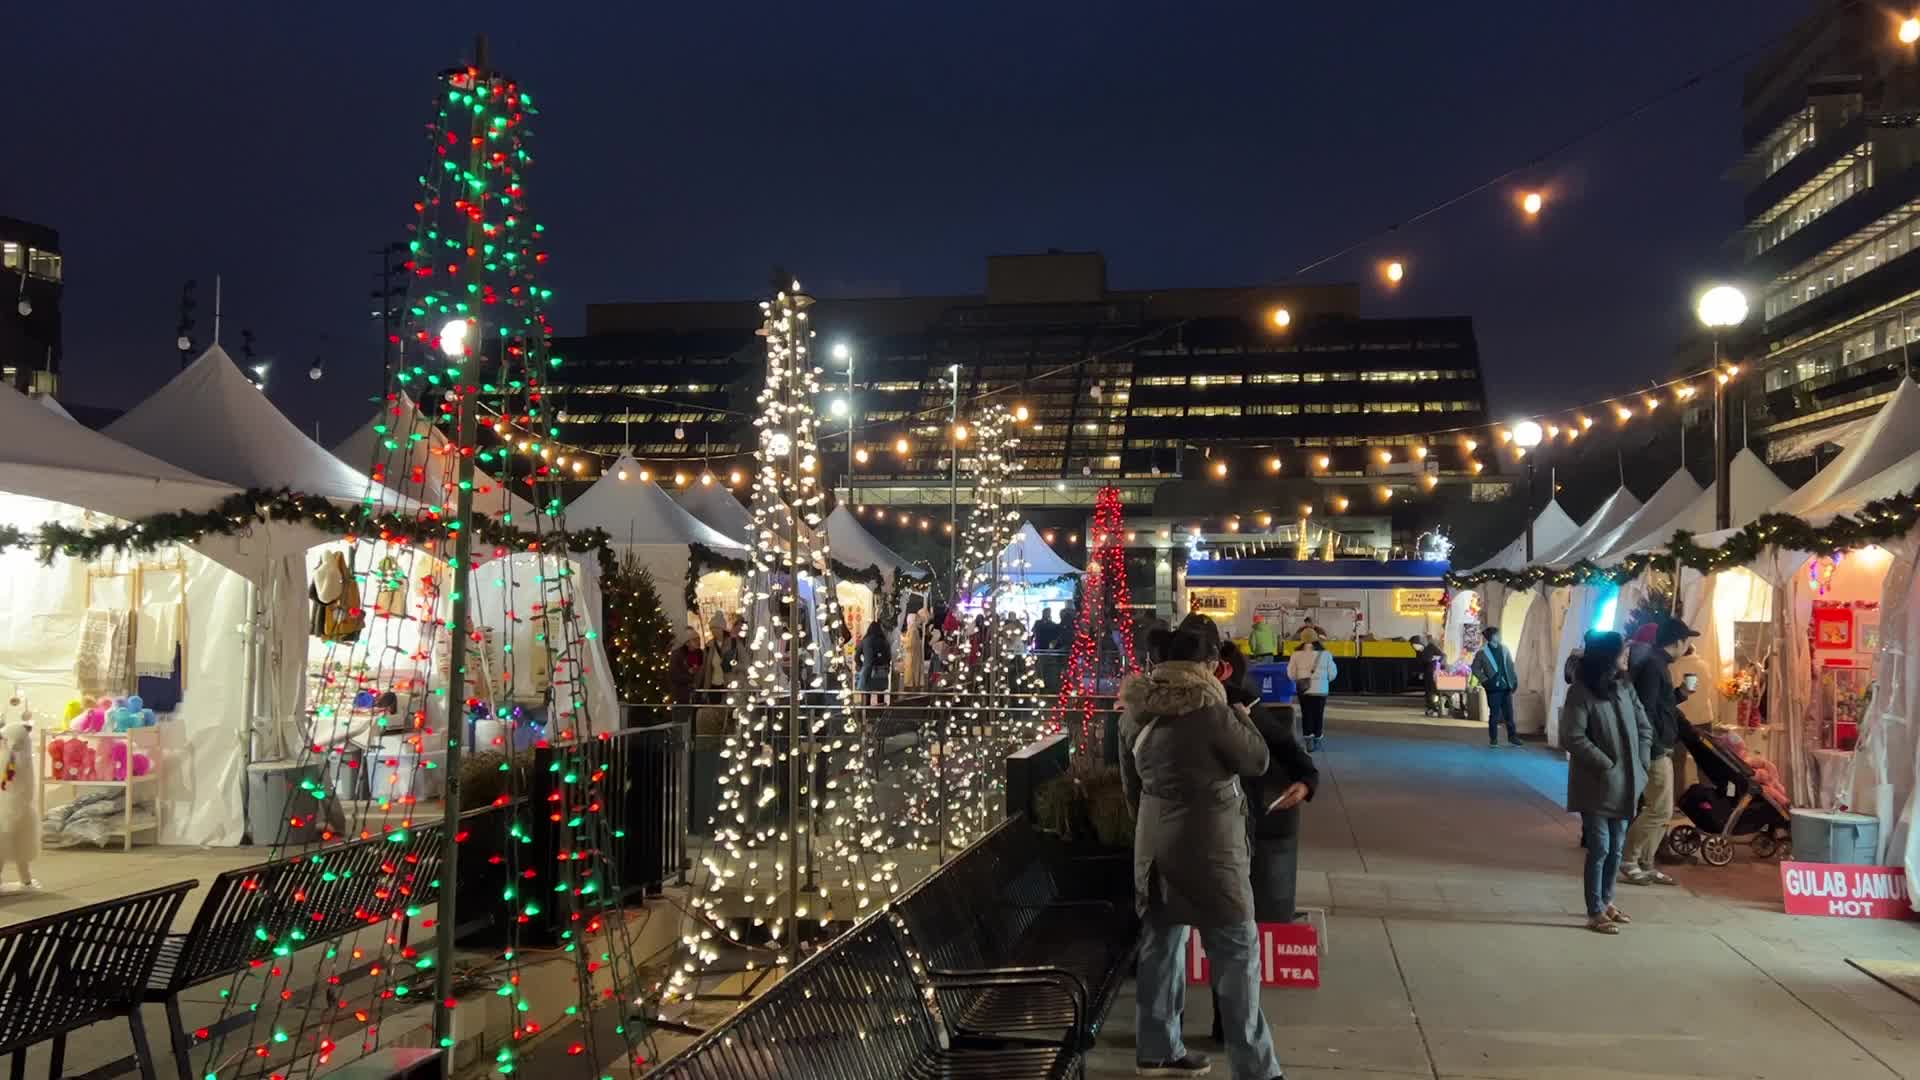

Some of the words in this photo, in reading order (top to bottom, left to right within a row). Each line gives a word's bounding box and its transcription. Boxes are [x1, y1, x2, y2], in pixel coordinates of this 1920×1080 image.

[1786, 869, 1848, 898] GULAB
[1828, 900, 1874, 916] HOT
[1277, 943, 1318, 957] KADAK
[1279, 967, 1315, 980] TEA
